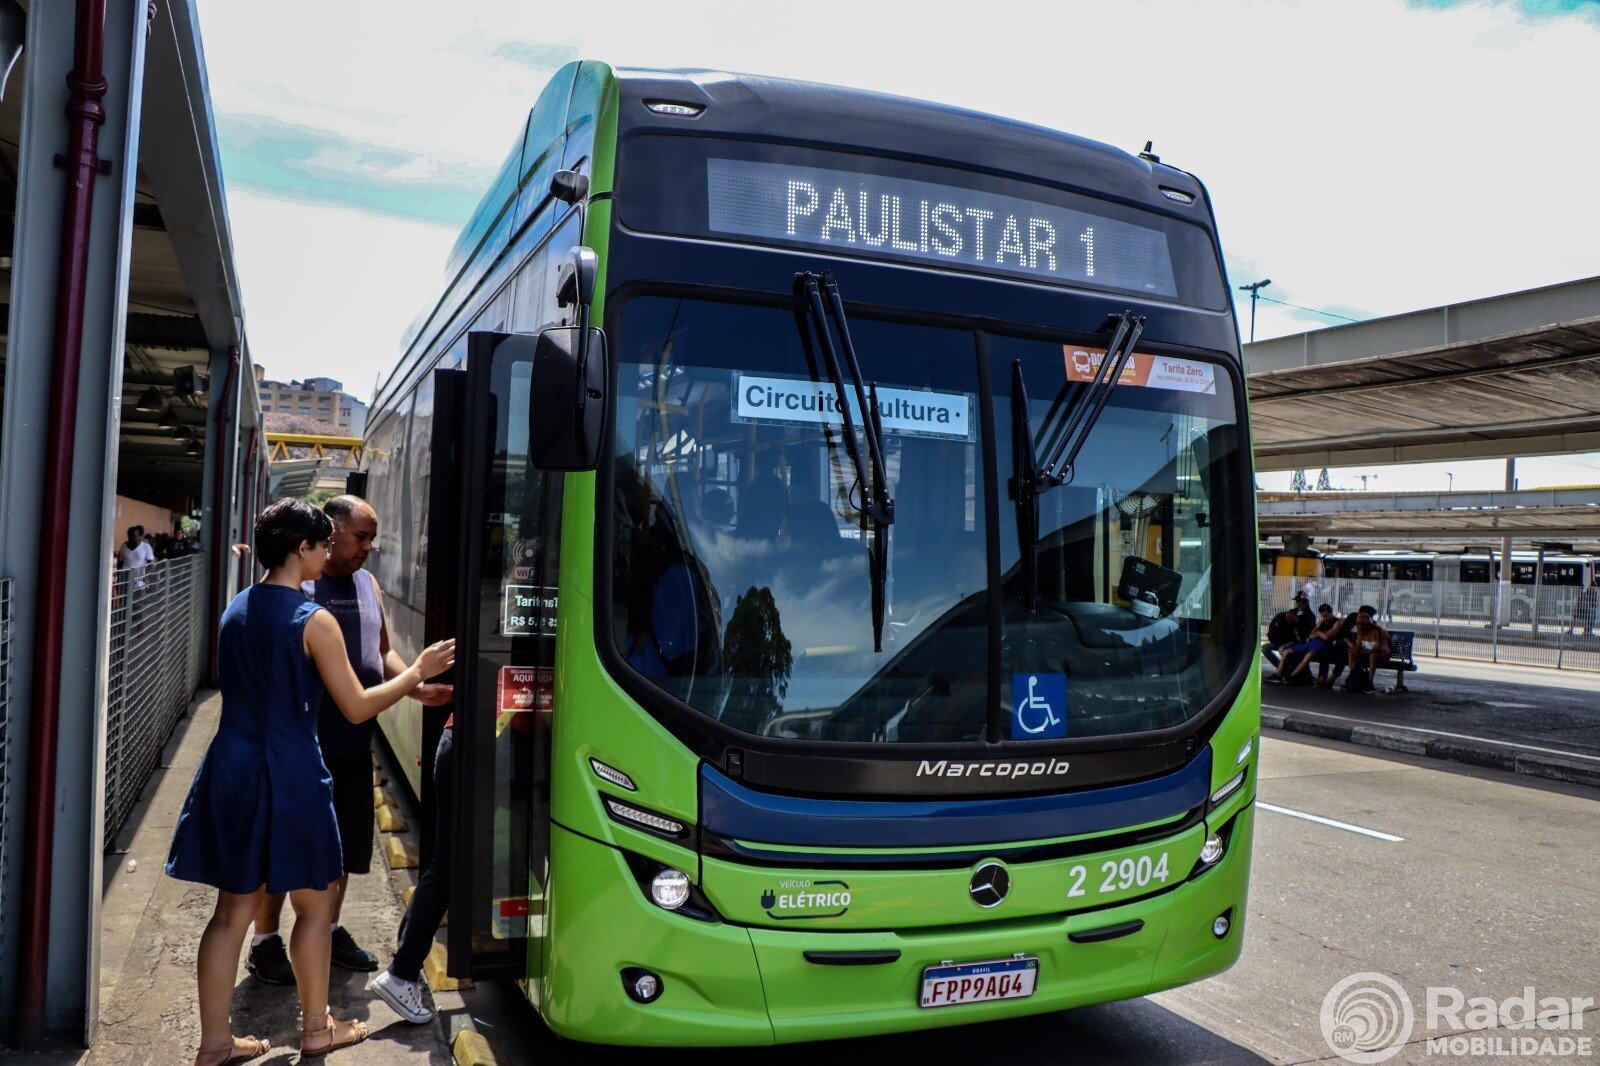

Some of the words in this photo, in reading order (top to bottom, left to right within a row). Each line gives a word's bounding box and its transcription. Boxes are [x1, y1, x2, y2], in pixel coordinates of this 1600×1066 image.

[788, 180, 1056, 271] PAULISTAR
[1080, 227, 1094, 276] 1
[1163, 362, 1185, 374] Tarifa
[1186, 365, 1204, 377] Zero
[866, 394, 950, 424] ultura
[916, 758, 1070, 780] Marcopolo
[780, 879, 811, 888] VEÍCULO
[1067, 865, 1087, 898] 2
[1099, 852, 1169, 893] 2904
[779, 891, 851, 909] ELÉTRICO
[931, 973, 1023, 1003] FPP9A04
